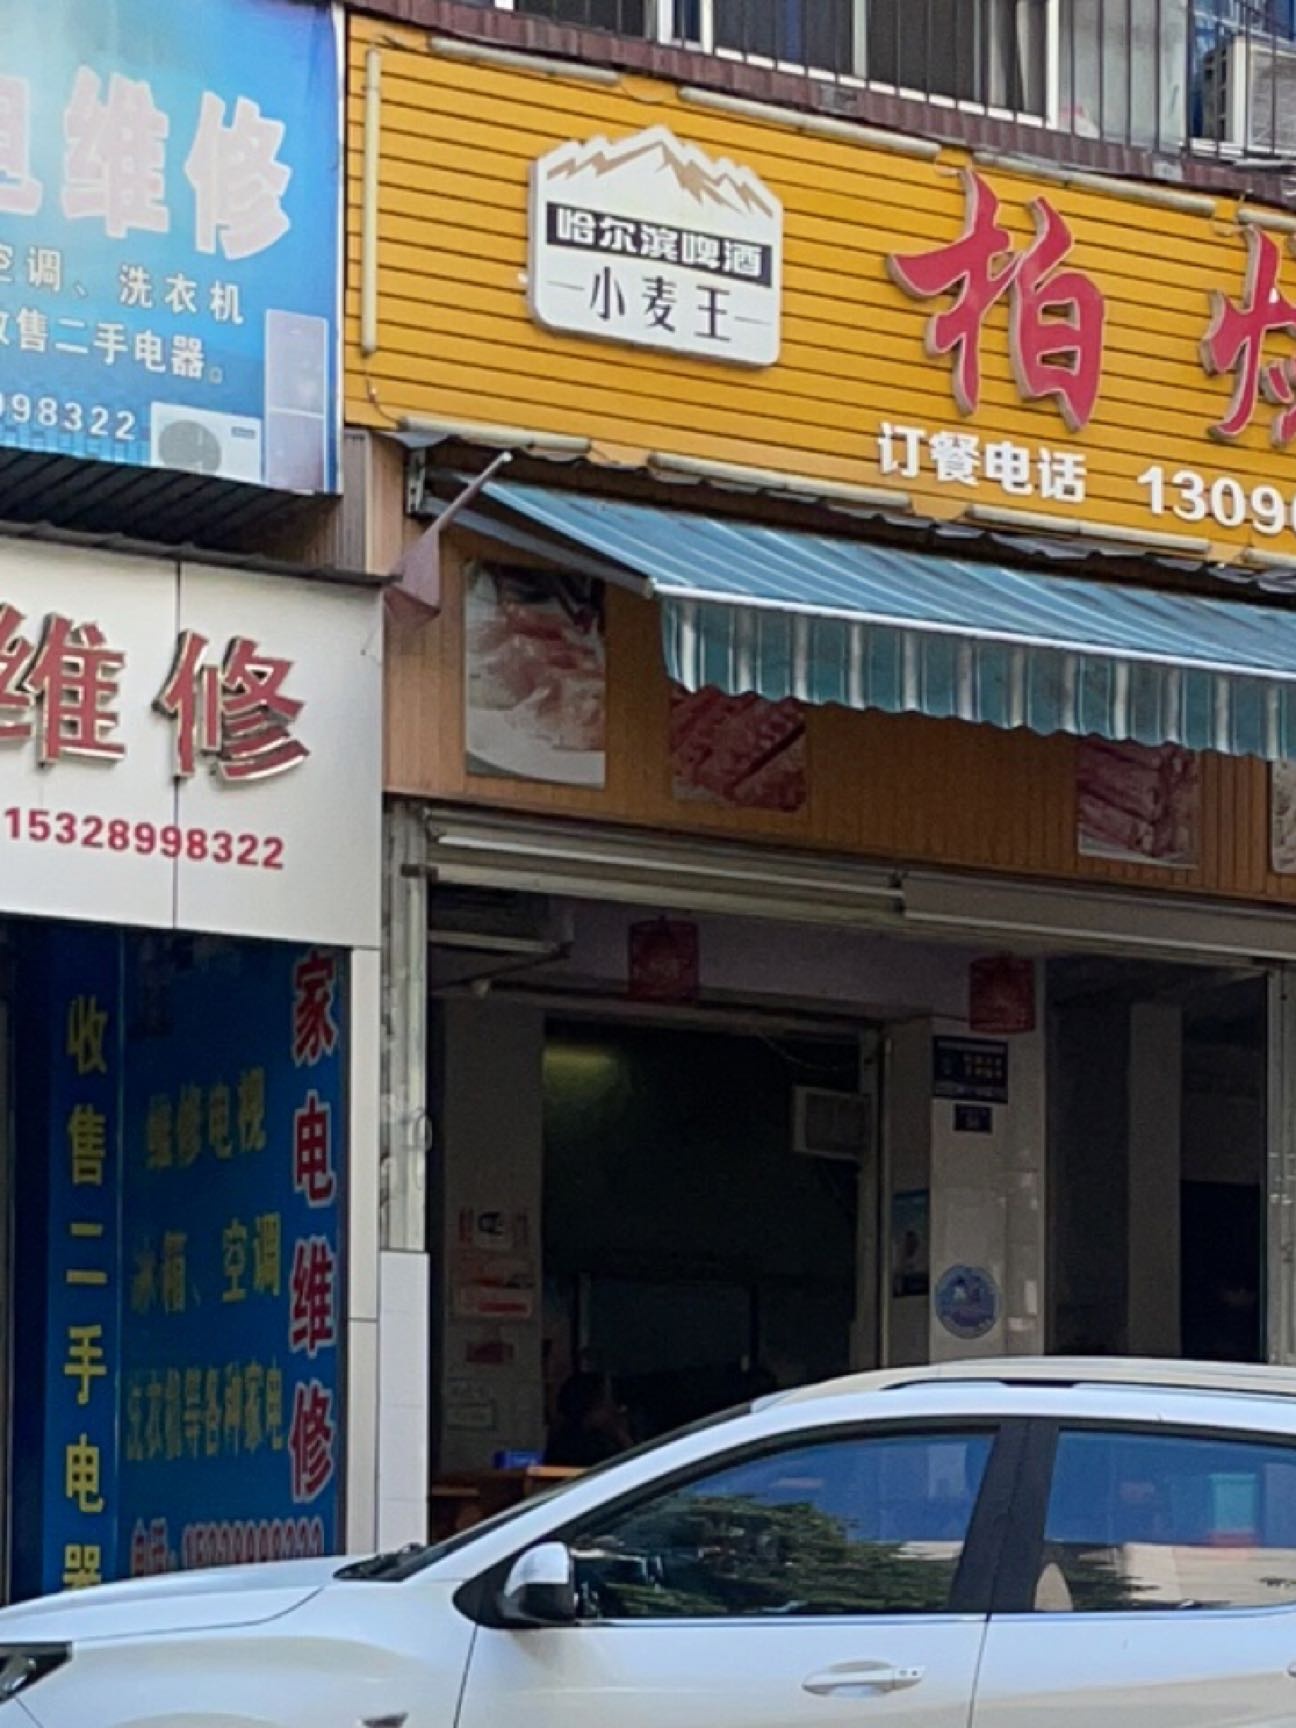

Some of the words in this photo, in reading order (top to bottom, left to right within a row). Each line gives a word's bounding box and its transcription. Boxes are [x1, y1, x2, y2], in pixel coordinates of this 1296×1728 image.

[555, 206, 765, 278] 哈尔滨啤酒
[589, 266, 732, 342] 小麦王
[0, 392, 136, 441] 98322
[877, 422, 1087, 503] 订餐电话
[0, 603, 311, 788] 维修
[5, 806, 285, 871] 15328998322
[289, 950, 342, 1506] 家电维修
